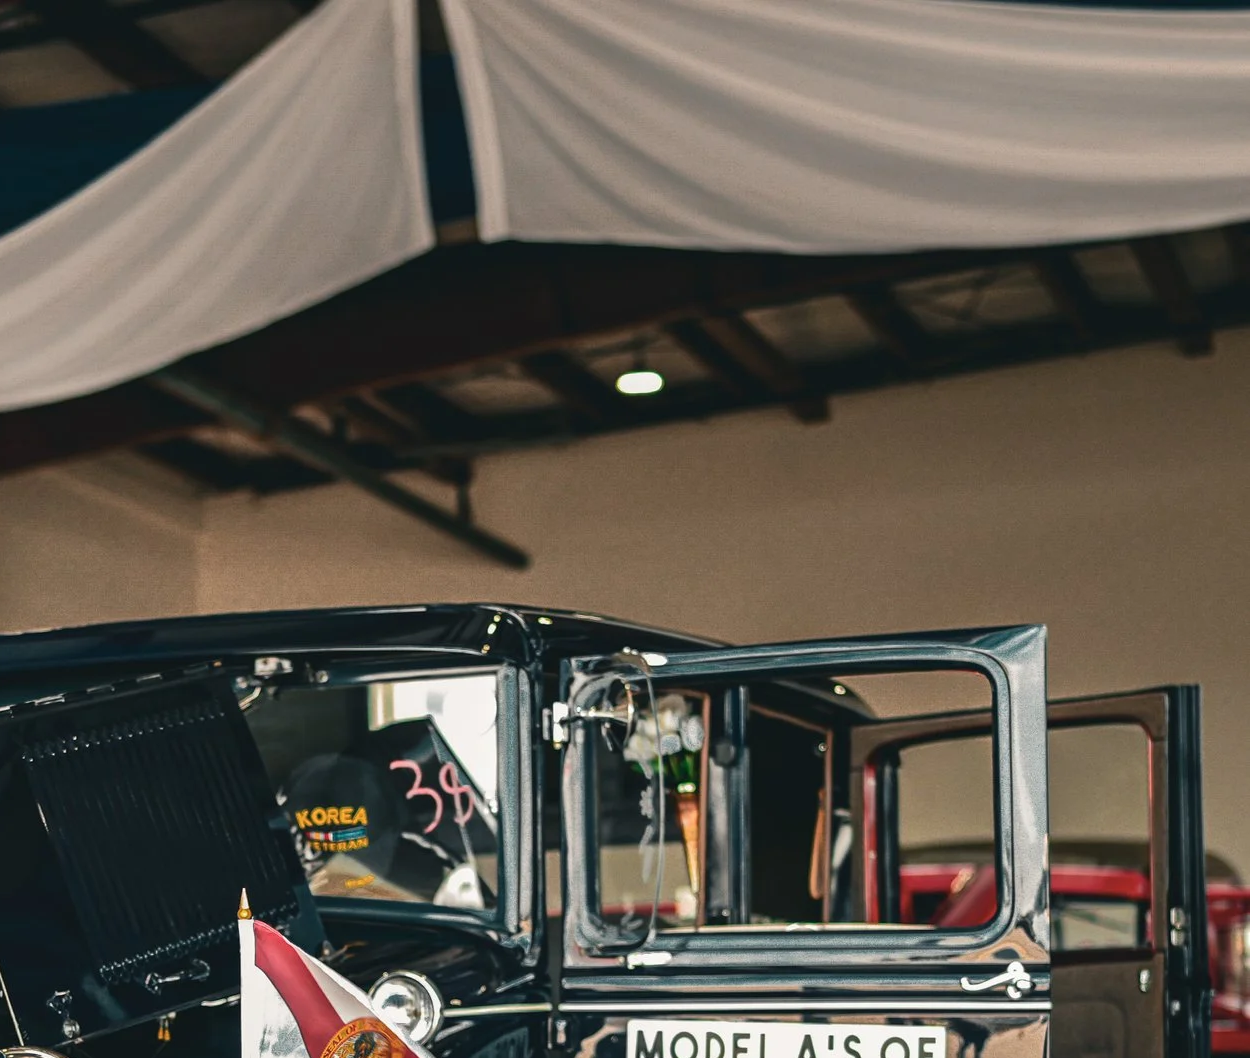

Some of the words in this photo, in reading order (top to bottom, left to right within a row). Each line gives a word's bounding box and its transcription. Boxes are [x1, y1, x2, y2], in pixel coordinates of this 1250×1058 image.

[389, 760, 475, 834] 38
[295, 806, 368, 829] KOREA
[309, 837, 370, 852] ETERAN
